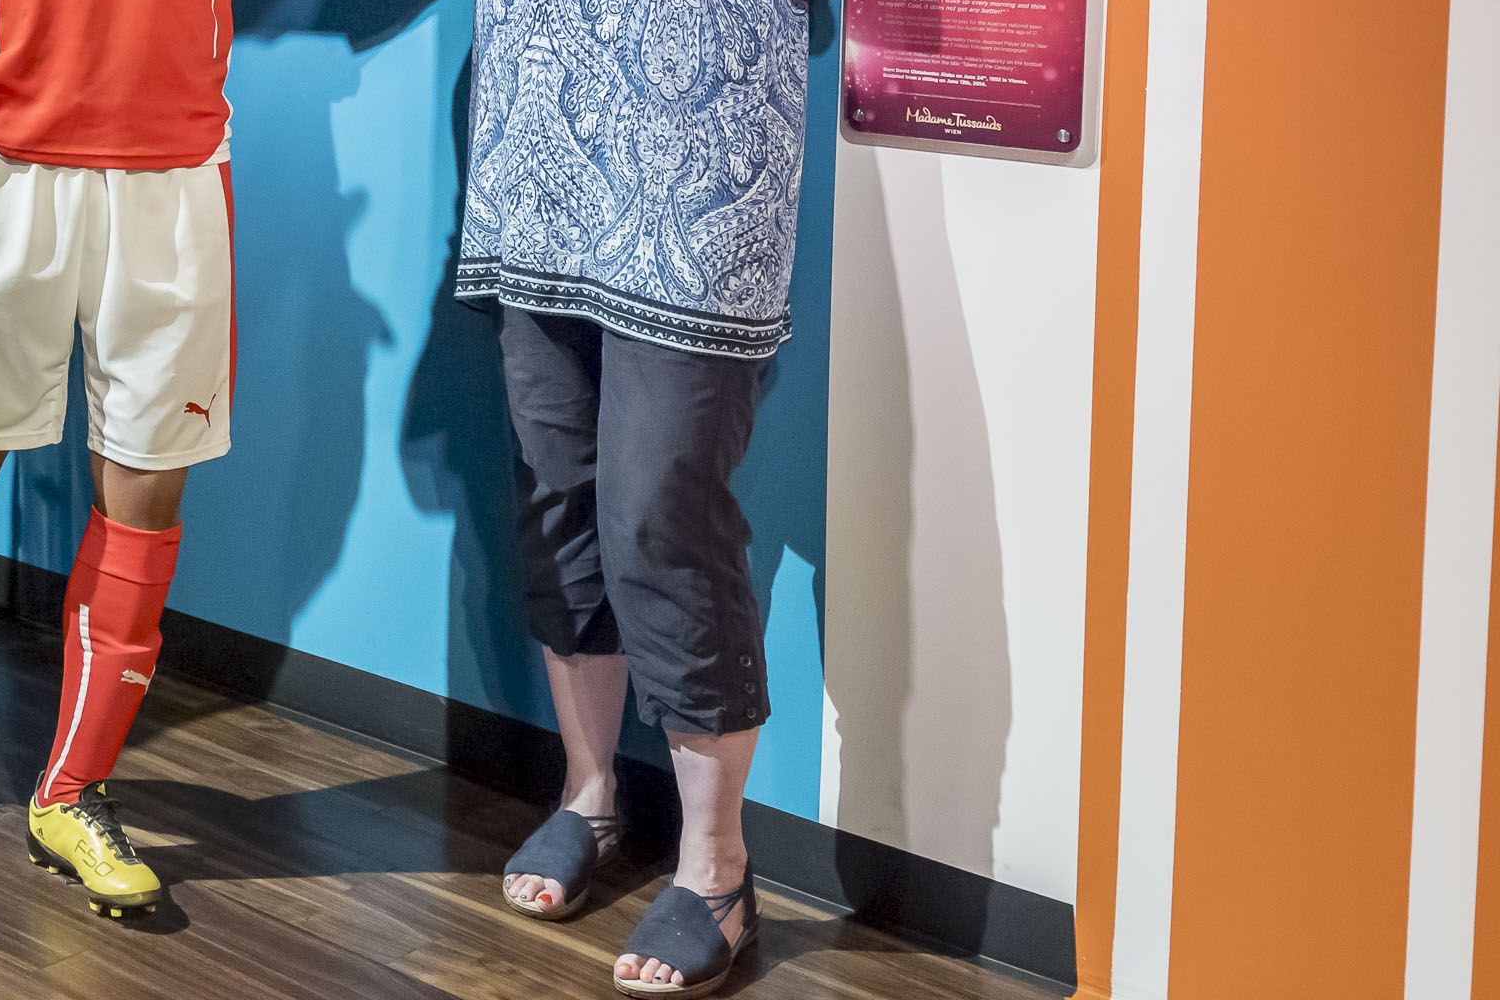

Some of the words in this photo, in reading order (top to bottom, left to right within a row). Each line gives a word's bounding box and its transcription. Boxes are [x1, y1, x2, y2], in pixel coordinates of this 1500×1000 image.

[906, 107, 955, 126] Madame
[952, 112, 1002, 131] Tussauds
[944, 128, 962, 136] WIEN
[74, 840, 115, 877] F50
